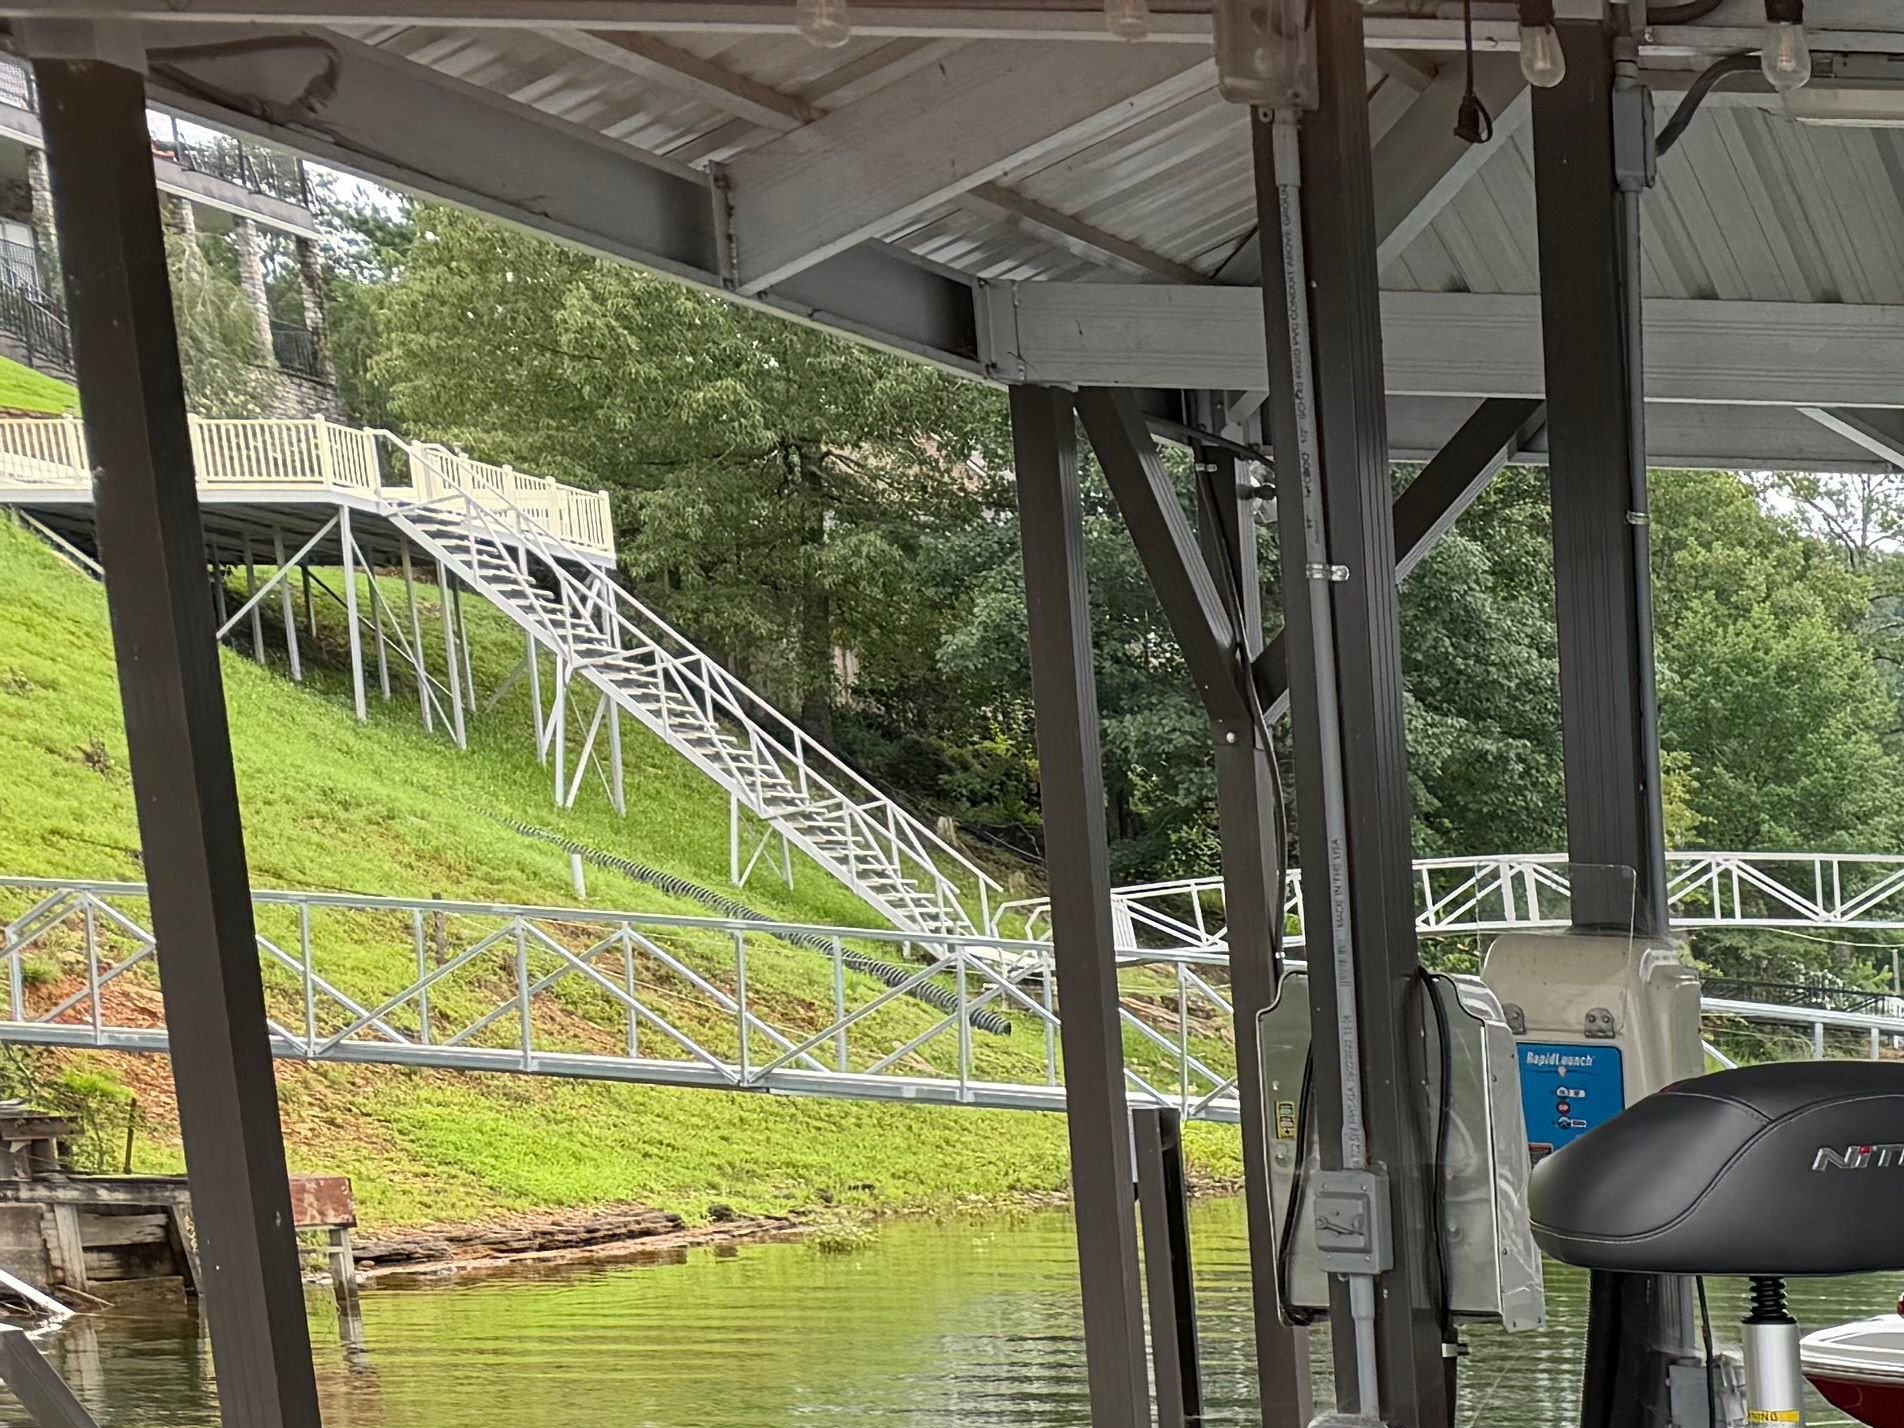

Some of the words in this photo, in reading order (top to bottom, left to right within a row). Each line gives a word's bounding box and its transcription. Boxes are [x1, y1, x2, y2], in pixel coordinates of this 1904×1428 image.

[1280, 184, 1291, 226] GROUN
[1283, 232, 1295, 267] ABOVE
[1285, 271, 1298, 320] CONDUIT
